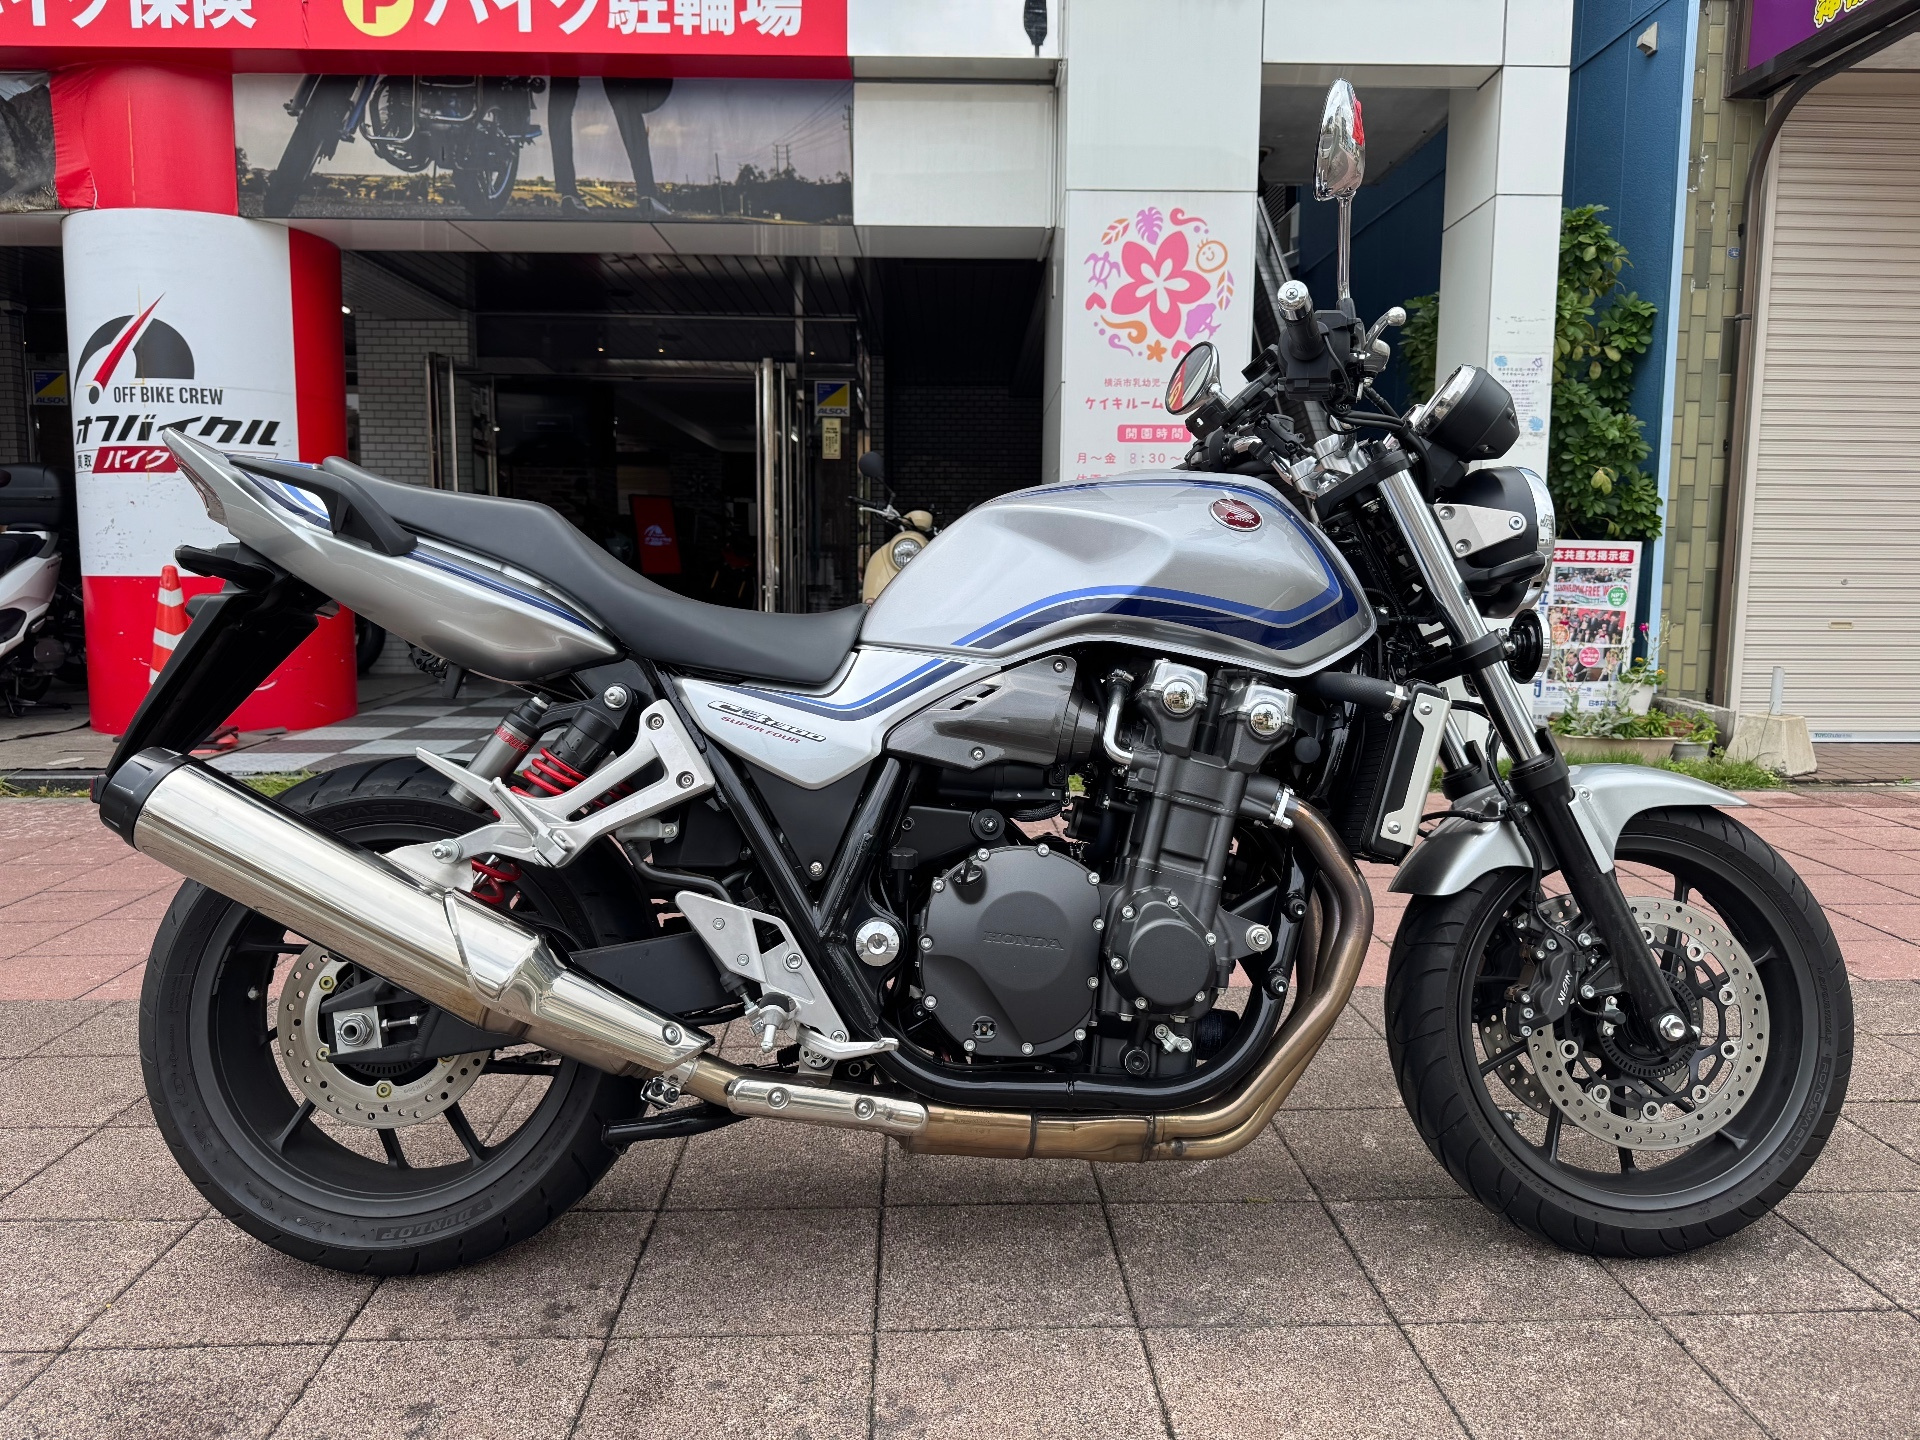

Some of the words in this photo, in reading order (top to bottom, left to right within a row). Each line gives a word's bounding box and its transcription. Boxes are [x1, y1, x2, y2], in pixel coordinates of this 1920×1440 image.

[36, 397, 66, 405] ALSOK
[113, 386, 136, 403] OFF
[140, 386, 175, 404] BIKE
[178, 387, 224, 405] CREW
[1085, 396, 1164, 411] ケイキルーム
[817, 407, 848, 415] ALSOK
[1125, 427, 1185, 440] 開園時間
[103, 449, 170, 470] バイク
[720, 716, 765, 733] SUPER
[765, 730, 801, 744] FOUR
[982, 931, 1064, 951] HONDA
[1792, 1062, 1829, 1147] ROADSMART
[381, 1209, 472, 1241] DUNLOP
